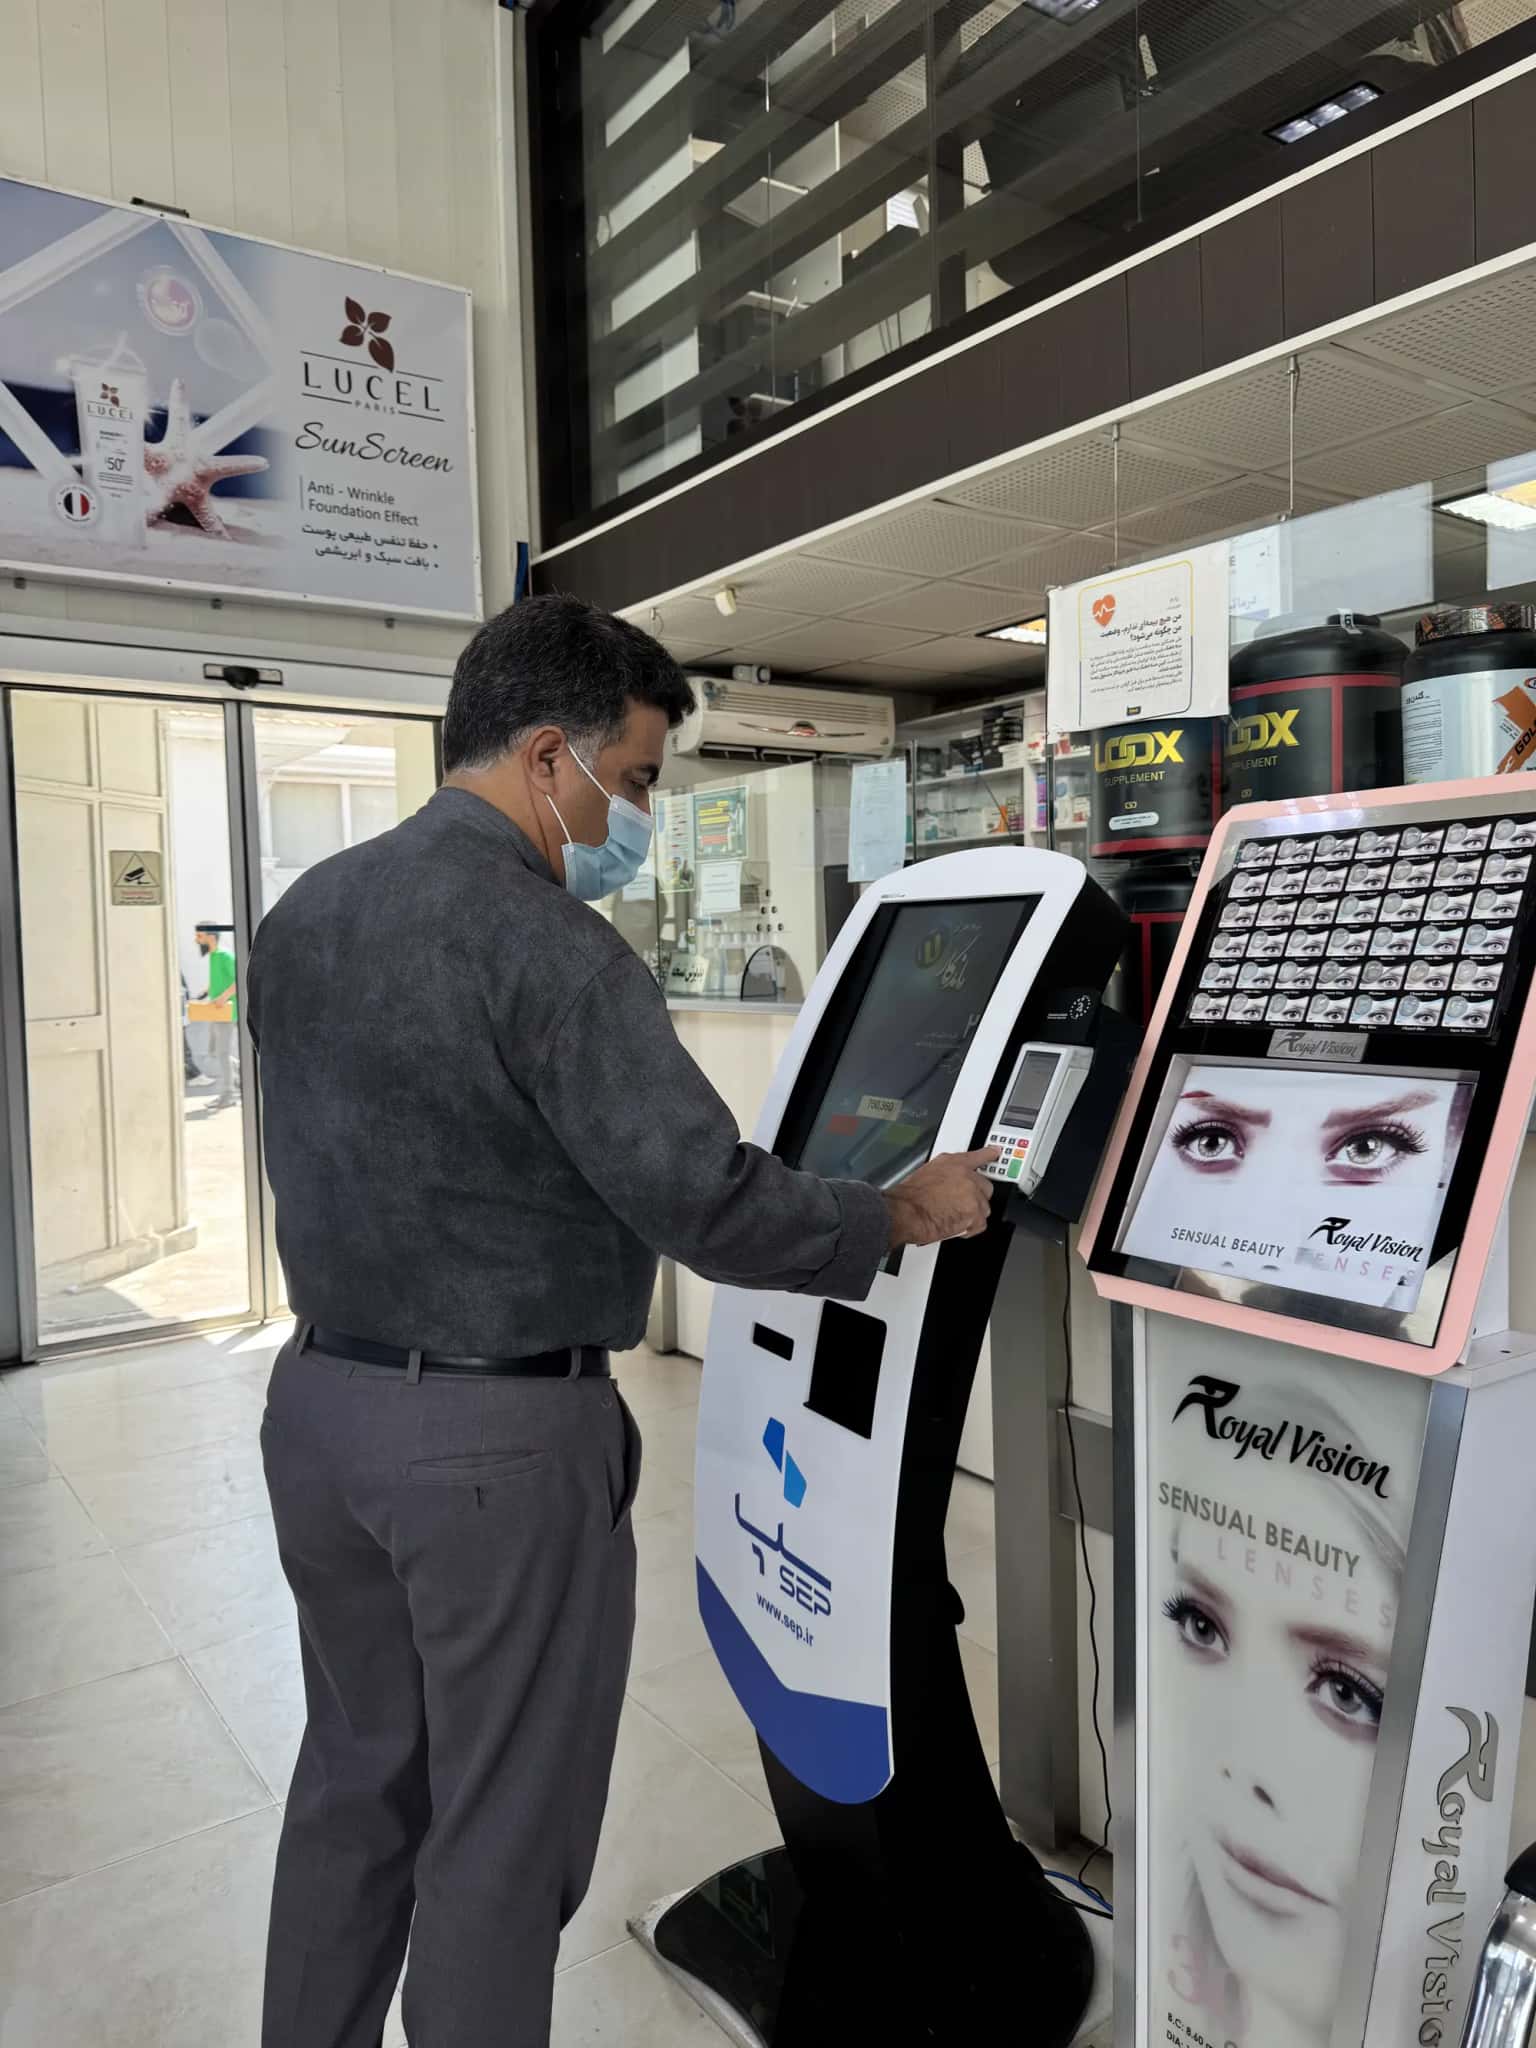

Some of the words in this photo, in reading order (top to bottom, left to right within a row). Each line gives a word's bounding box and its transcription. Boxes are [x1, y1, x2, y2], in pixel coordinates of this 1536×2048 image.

[304, 362, 440, 412] LUCEL
[355, 401, 396, 415] PARIS
[295, 422, 454, 473] SunScreen
[307, 481, 335, 496] Anti
[347, 486, 395, 505] Wrinkle
[308, 499, 381, 521] Foundation
[384, 509, 419, 527] Effect
[1227, 709, 1300, 757] OOX
[1514, 718, 1536, 755] GOL
[1171, 1227, 1227, 1250] SENSUAL
[1231, 1238, 1285, 1259] BEAUTY
[1307, 1216, 1375, 1254] Royal
[1370, 1234, 1424, 1262] Vision
[1171, 1375, 1289, 1461] Royal
[1288, 1424, 1391, 1499] Vision
[1158, 1482, 1257, 1540] SENSUAL
[1265, 1521, 1361, 1578] BEAUTY
[779, 1563, 832, 1617] SEP
[1217, 1536, 1394, 1629] LENSES
[756, 1591, 815, 1648] www.sep.ir
[1422, 1706, 1499, 1906] Royal
